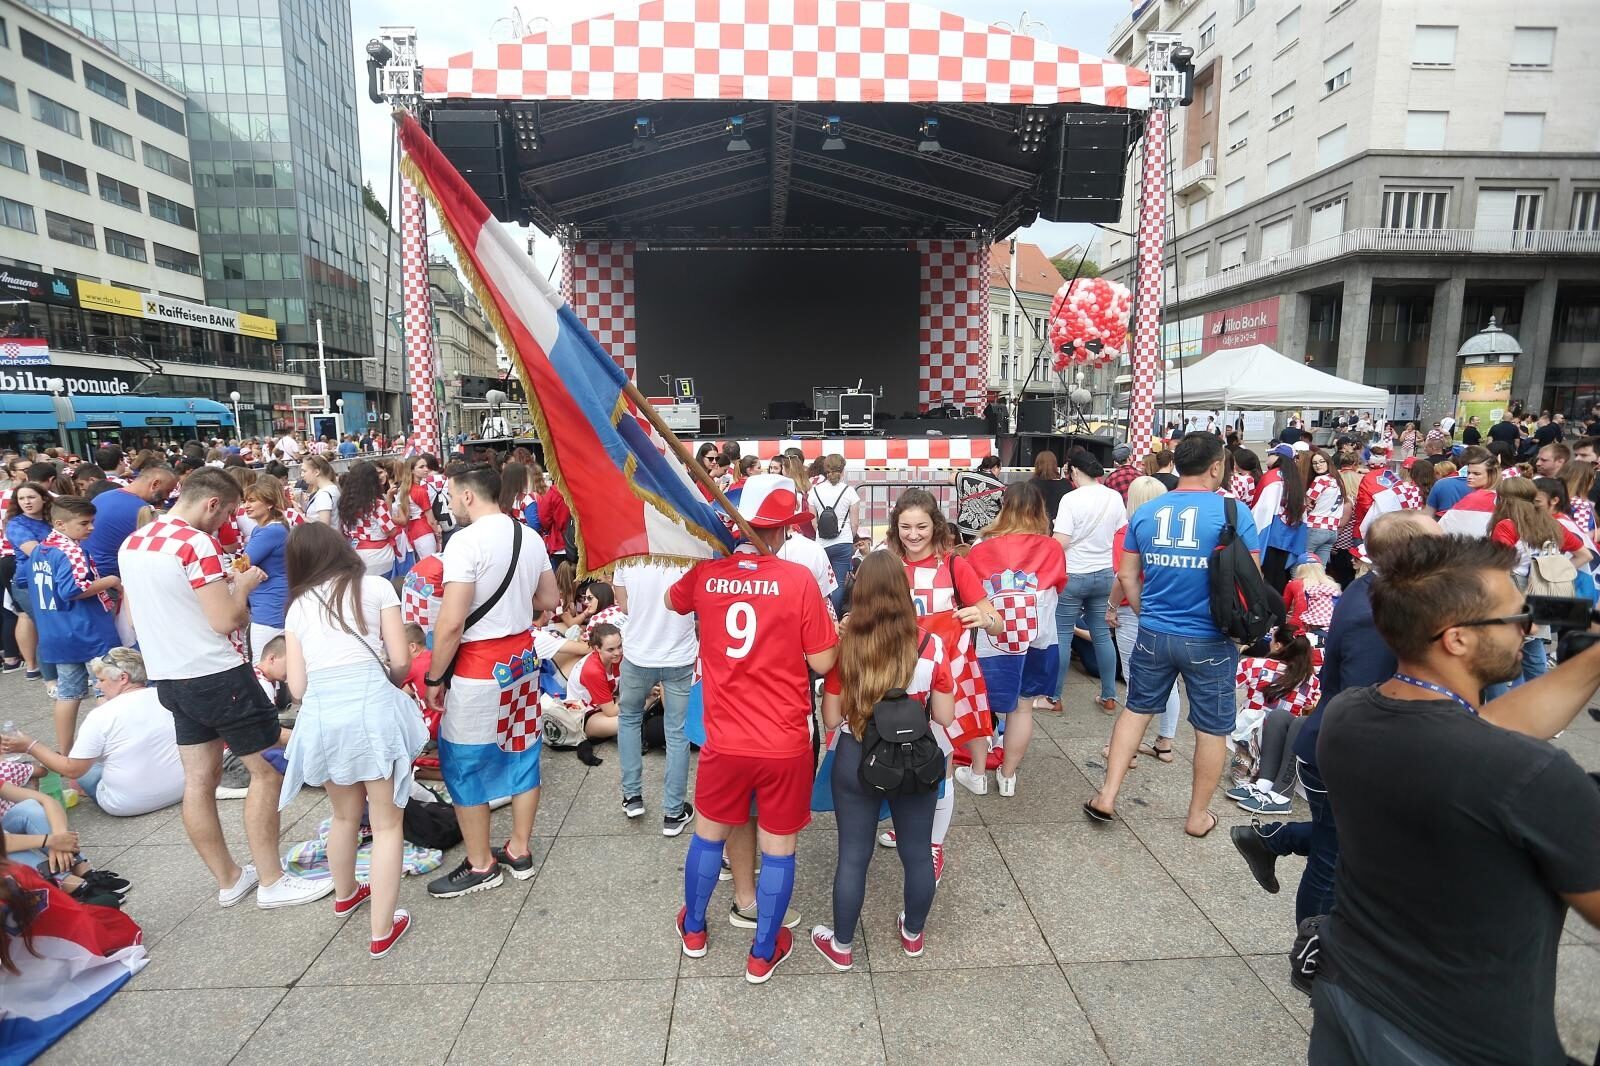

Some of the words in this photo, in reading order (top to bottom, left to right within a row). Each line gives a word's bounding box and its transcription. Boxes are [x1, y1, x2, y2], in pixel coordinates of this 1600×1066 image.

[158, 304, 208, 324] Raiffeisen
[209, 314, 236, 329] BANK
[1241, 312, 1267, 329] Bank
[13, 358, 50, 366] POŽEGA
[0, 371, 64, 391] biln
[65, 377, 129, 396] ponude
[1152, 505, 1200, 550] 11
[1145, 552, 1209, 569] CROATIA
[705, 577, 780, 596] CROATIA
[725, 601, 757, 659] 9
